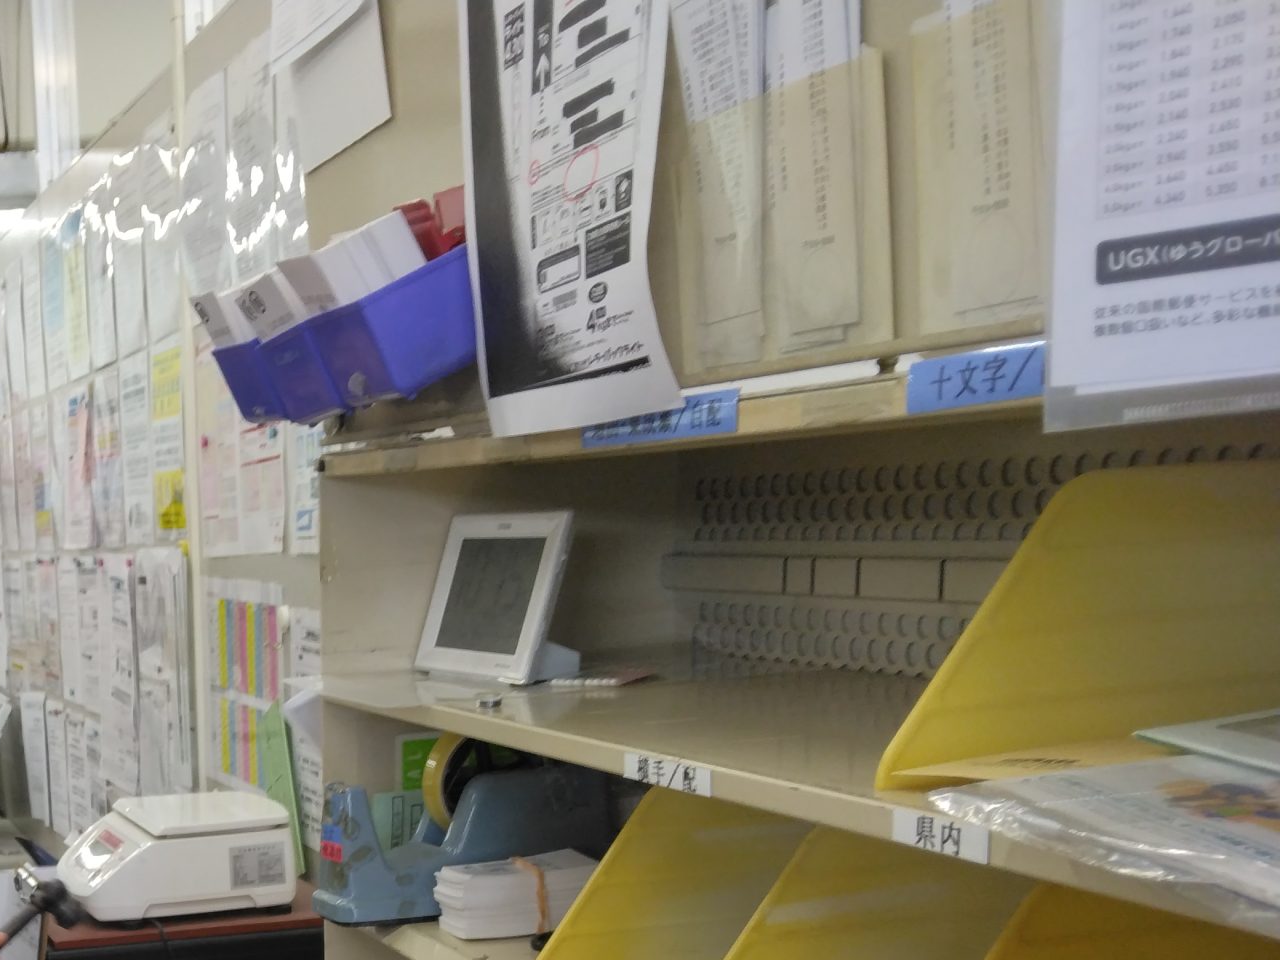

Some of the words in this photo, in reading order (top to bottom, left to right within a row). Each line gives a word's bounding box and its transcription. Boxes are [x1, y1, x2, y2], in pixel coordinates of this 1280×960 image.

[931, 348, 1046, 401] 十文字/
[915, 816, 962, 857] 県内
